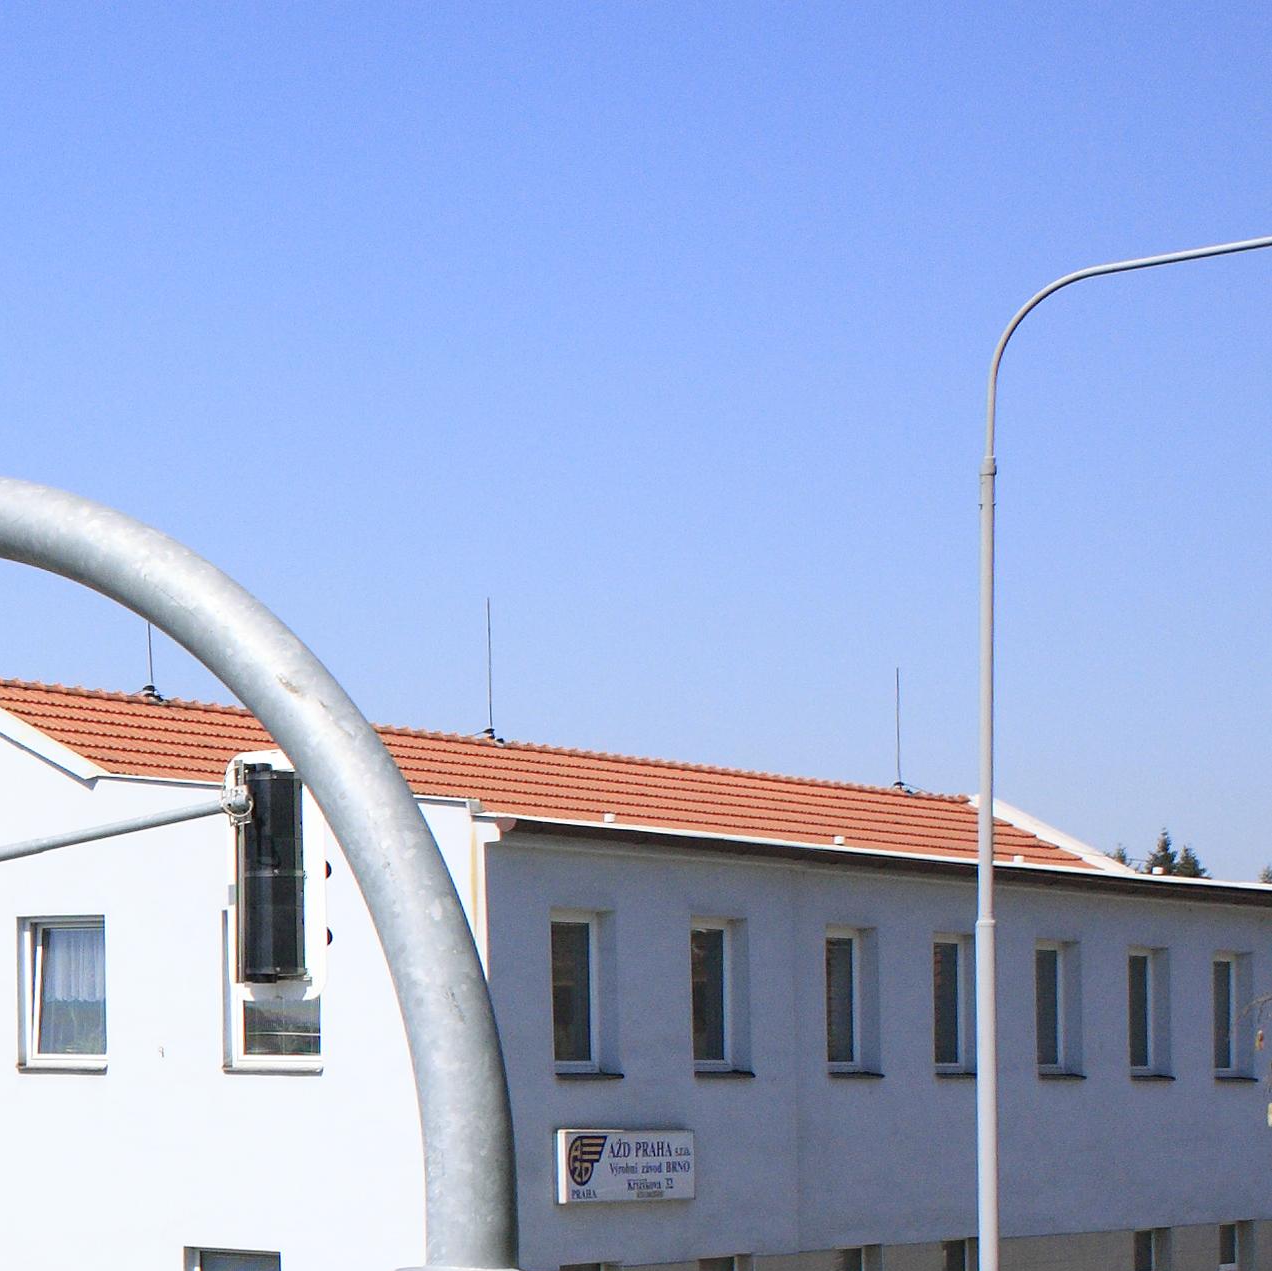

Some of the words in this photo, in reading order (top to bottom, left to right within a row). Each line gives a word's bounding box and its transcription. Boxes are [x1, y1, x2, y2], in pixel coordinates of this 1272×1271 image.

[608, 1139, 631, 1158] AŽD
[635, 1141, 672, 1157] PRAHA
[666, 1161, 690, 1173] BRNO
